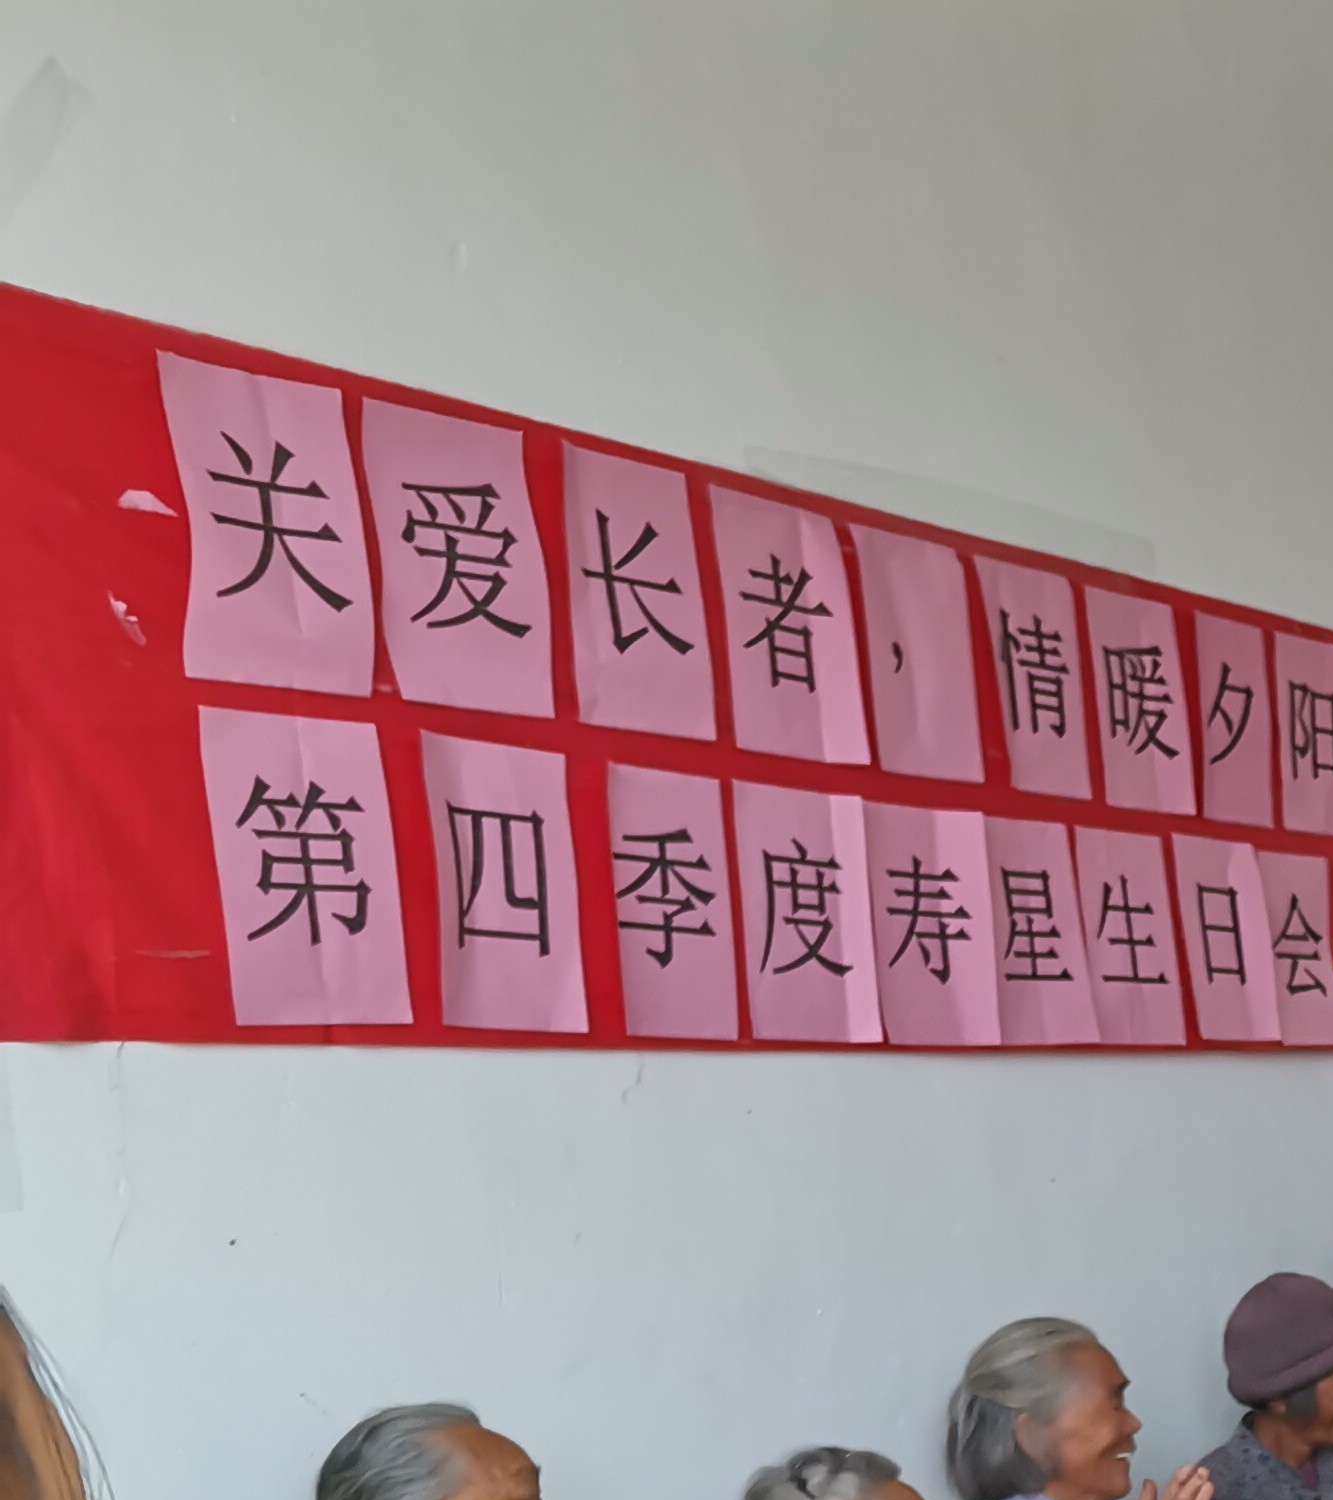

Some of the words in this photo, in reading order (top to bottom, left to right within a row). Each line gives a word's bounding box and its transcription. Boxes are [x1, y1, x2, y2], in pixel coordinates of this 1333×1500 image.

[235, 774, 1328, 997] 第四季度寿星生日会
